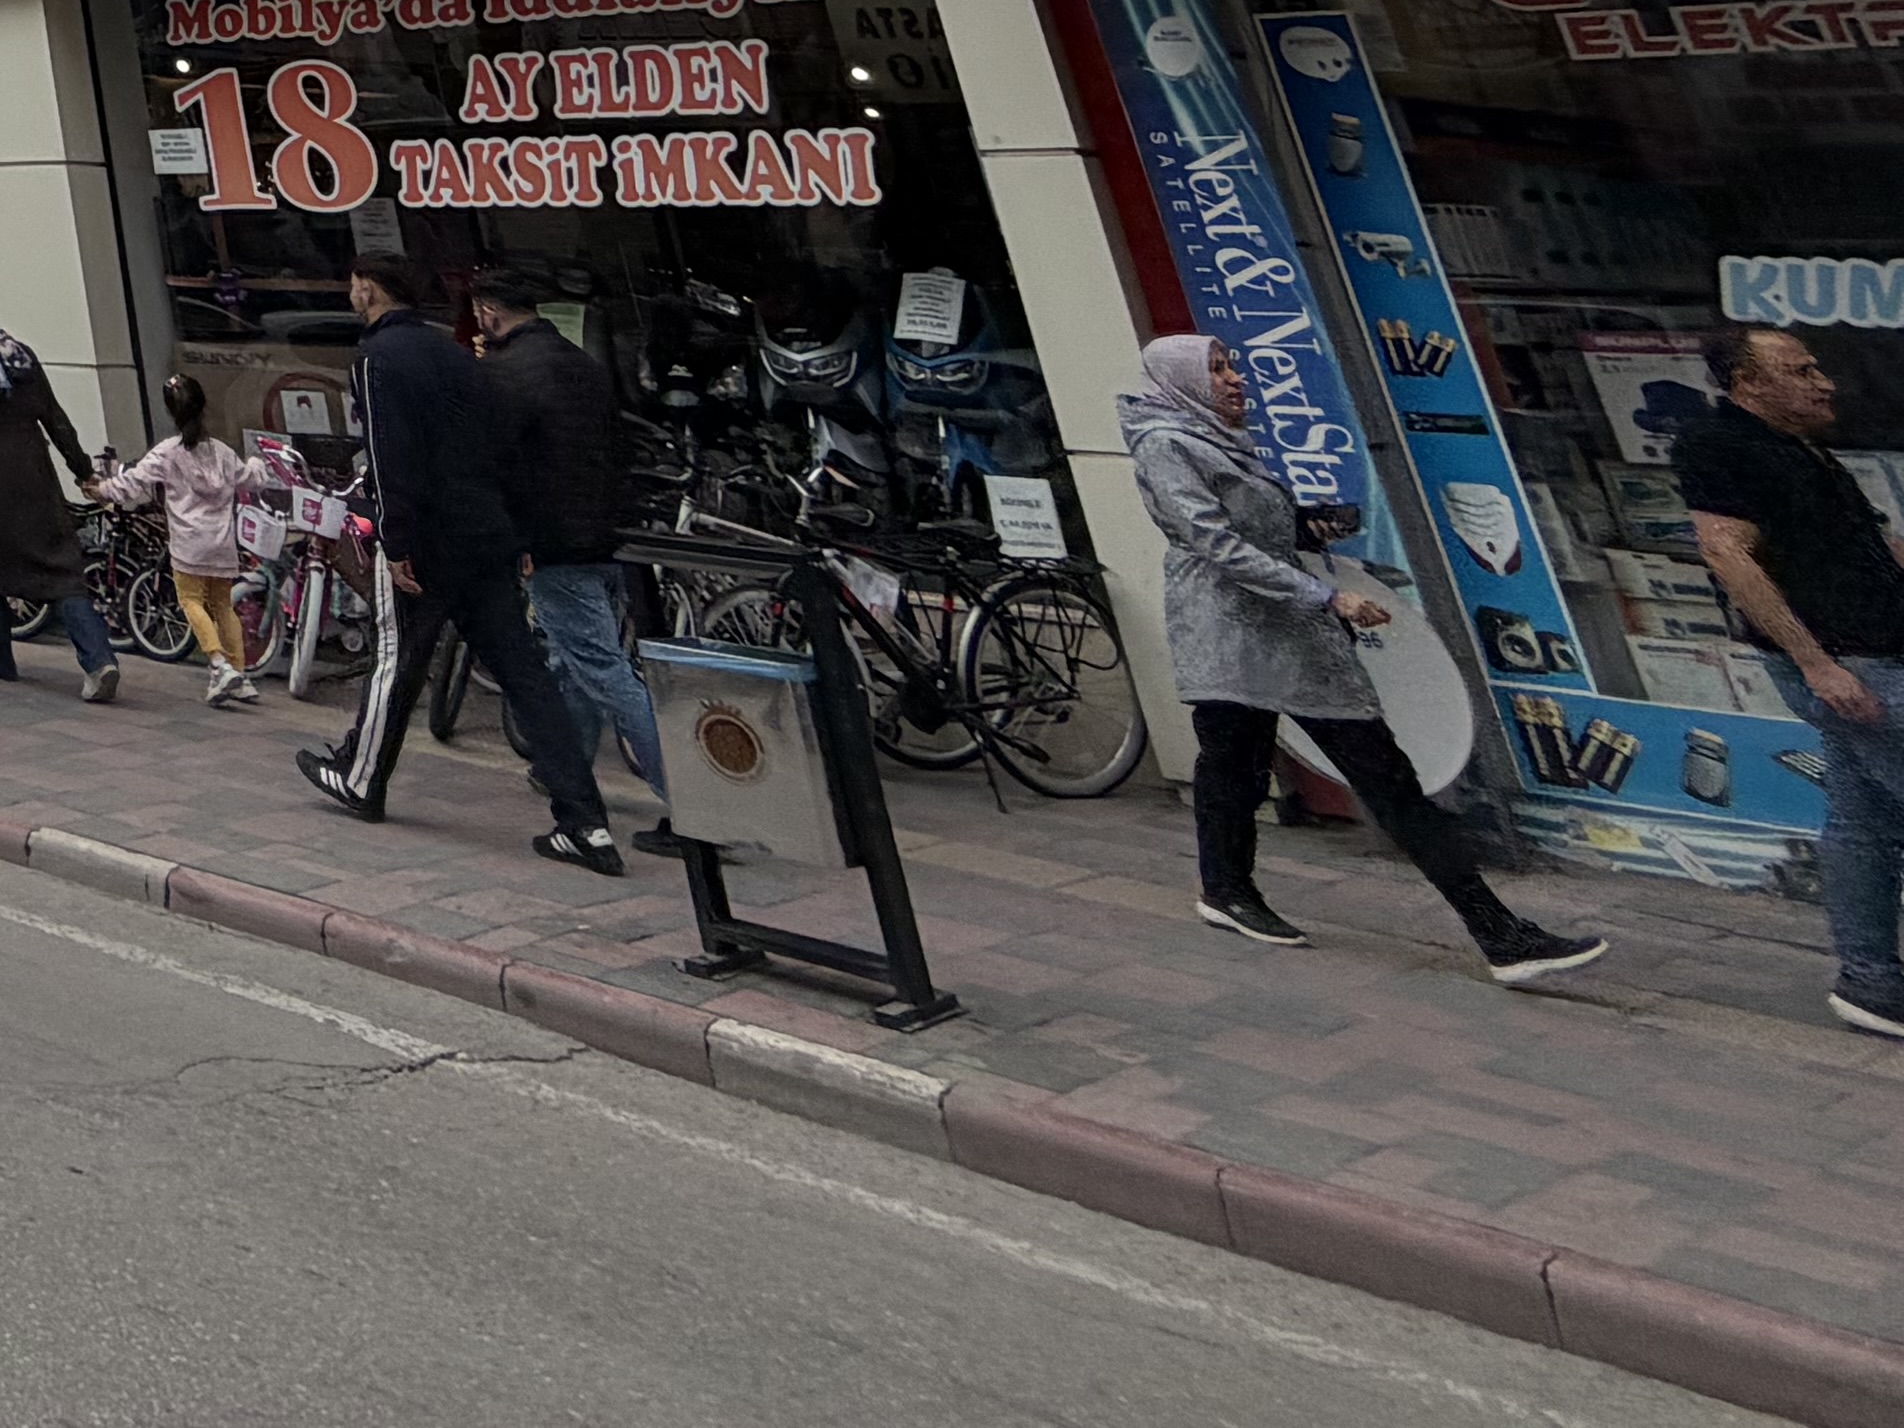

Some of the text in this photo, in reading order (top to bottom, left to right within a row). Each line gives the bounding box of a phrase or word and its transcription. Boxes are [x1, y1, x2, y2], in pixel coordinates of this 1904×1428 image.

[174, 60, 380, 215] 18
[459, 38, 770, 126] AY ELDEN
[1148, 129, 1228, 321] SATELLITE
[1173, 129, 1263, 242] Next
[1214, 246, 1296, 299] &
